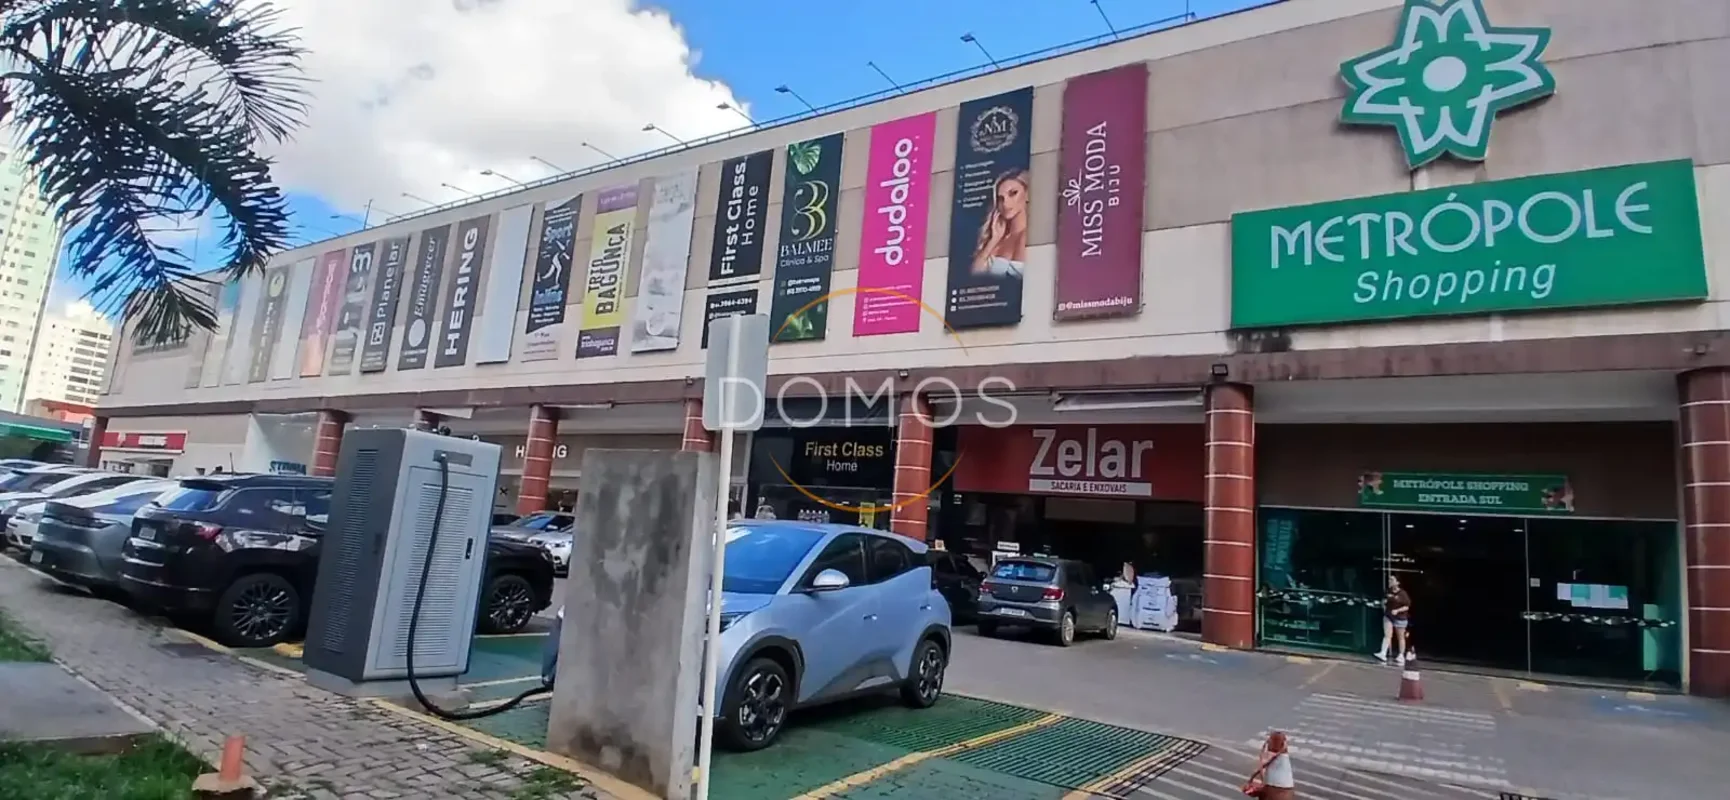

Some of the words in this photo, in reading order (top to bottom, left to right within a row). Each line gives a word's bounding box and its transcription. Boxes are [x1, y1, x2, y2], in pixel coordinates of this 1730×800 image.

[1084, 120, 1107, 193] MODA
[727, 161, 747, 220] Class
[874, 137, 914, 266] dudaloo
[1108, 165, 1121, 207] BIJU
[741, 185, 758, 246] Home
[1081, 200, 1104, 257] MISS
[1269, 180, 1654, 271] METRÓPOLE
[596, 222, 627, 315] BAGUNÇA
[721, 223, 739, 276] First
[780, 238, 833, 257] BALMEE
[814, 254, 830, 263] Spa
[377, 241, 400, 319] Planejar
[445, 227, 480, 356] HERING
[1352, 259, 1558, 306] Shopping
[804, 440, 838, 457] First
[841, 441, 885, 458] Class
[826, 459, 858, 472] Home
[1028, 428, 1154, 479] Zelar
[1050, 480, 1079, 493] SACARIA
[1080, 481, 1086, 492] E
[1088, 481, 1128, 494] ENXOVAIS
[1417, 493, 1477, 505] ENTRADA
[1478, 495, 1504, 506] SUL
[1466, 480, 1530, 492] SHOPPING
